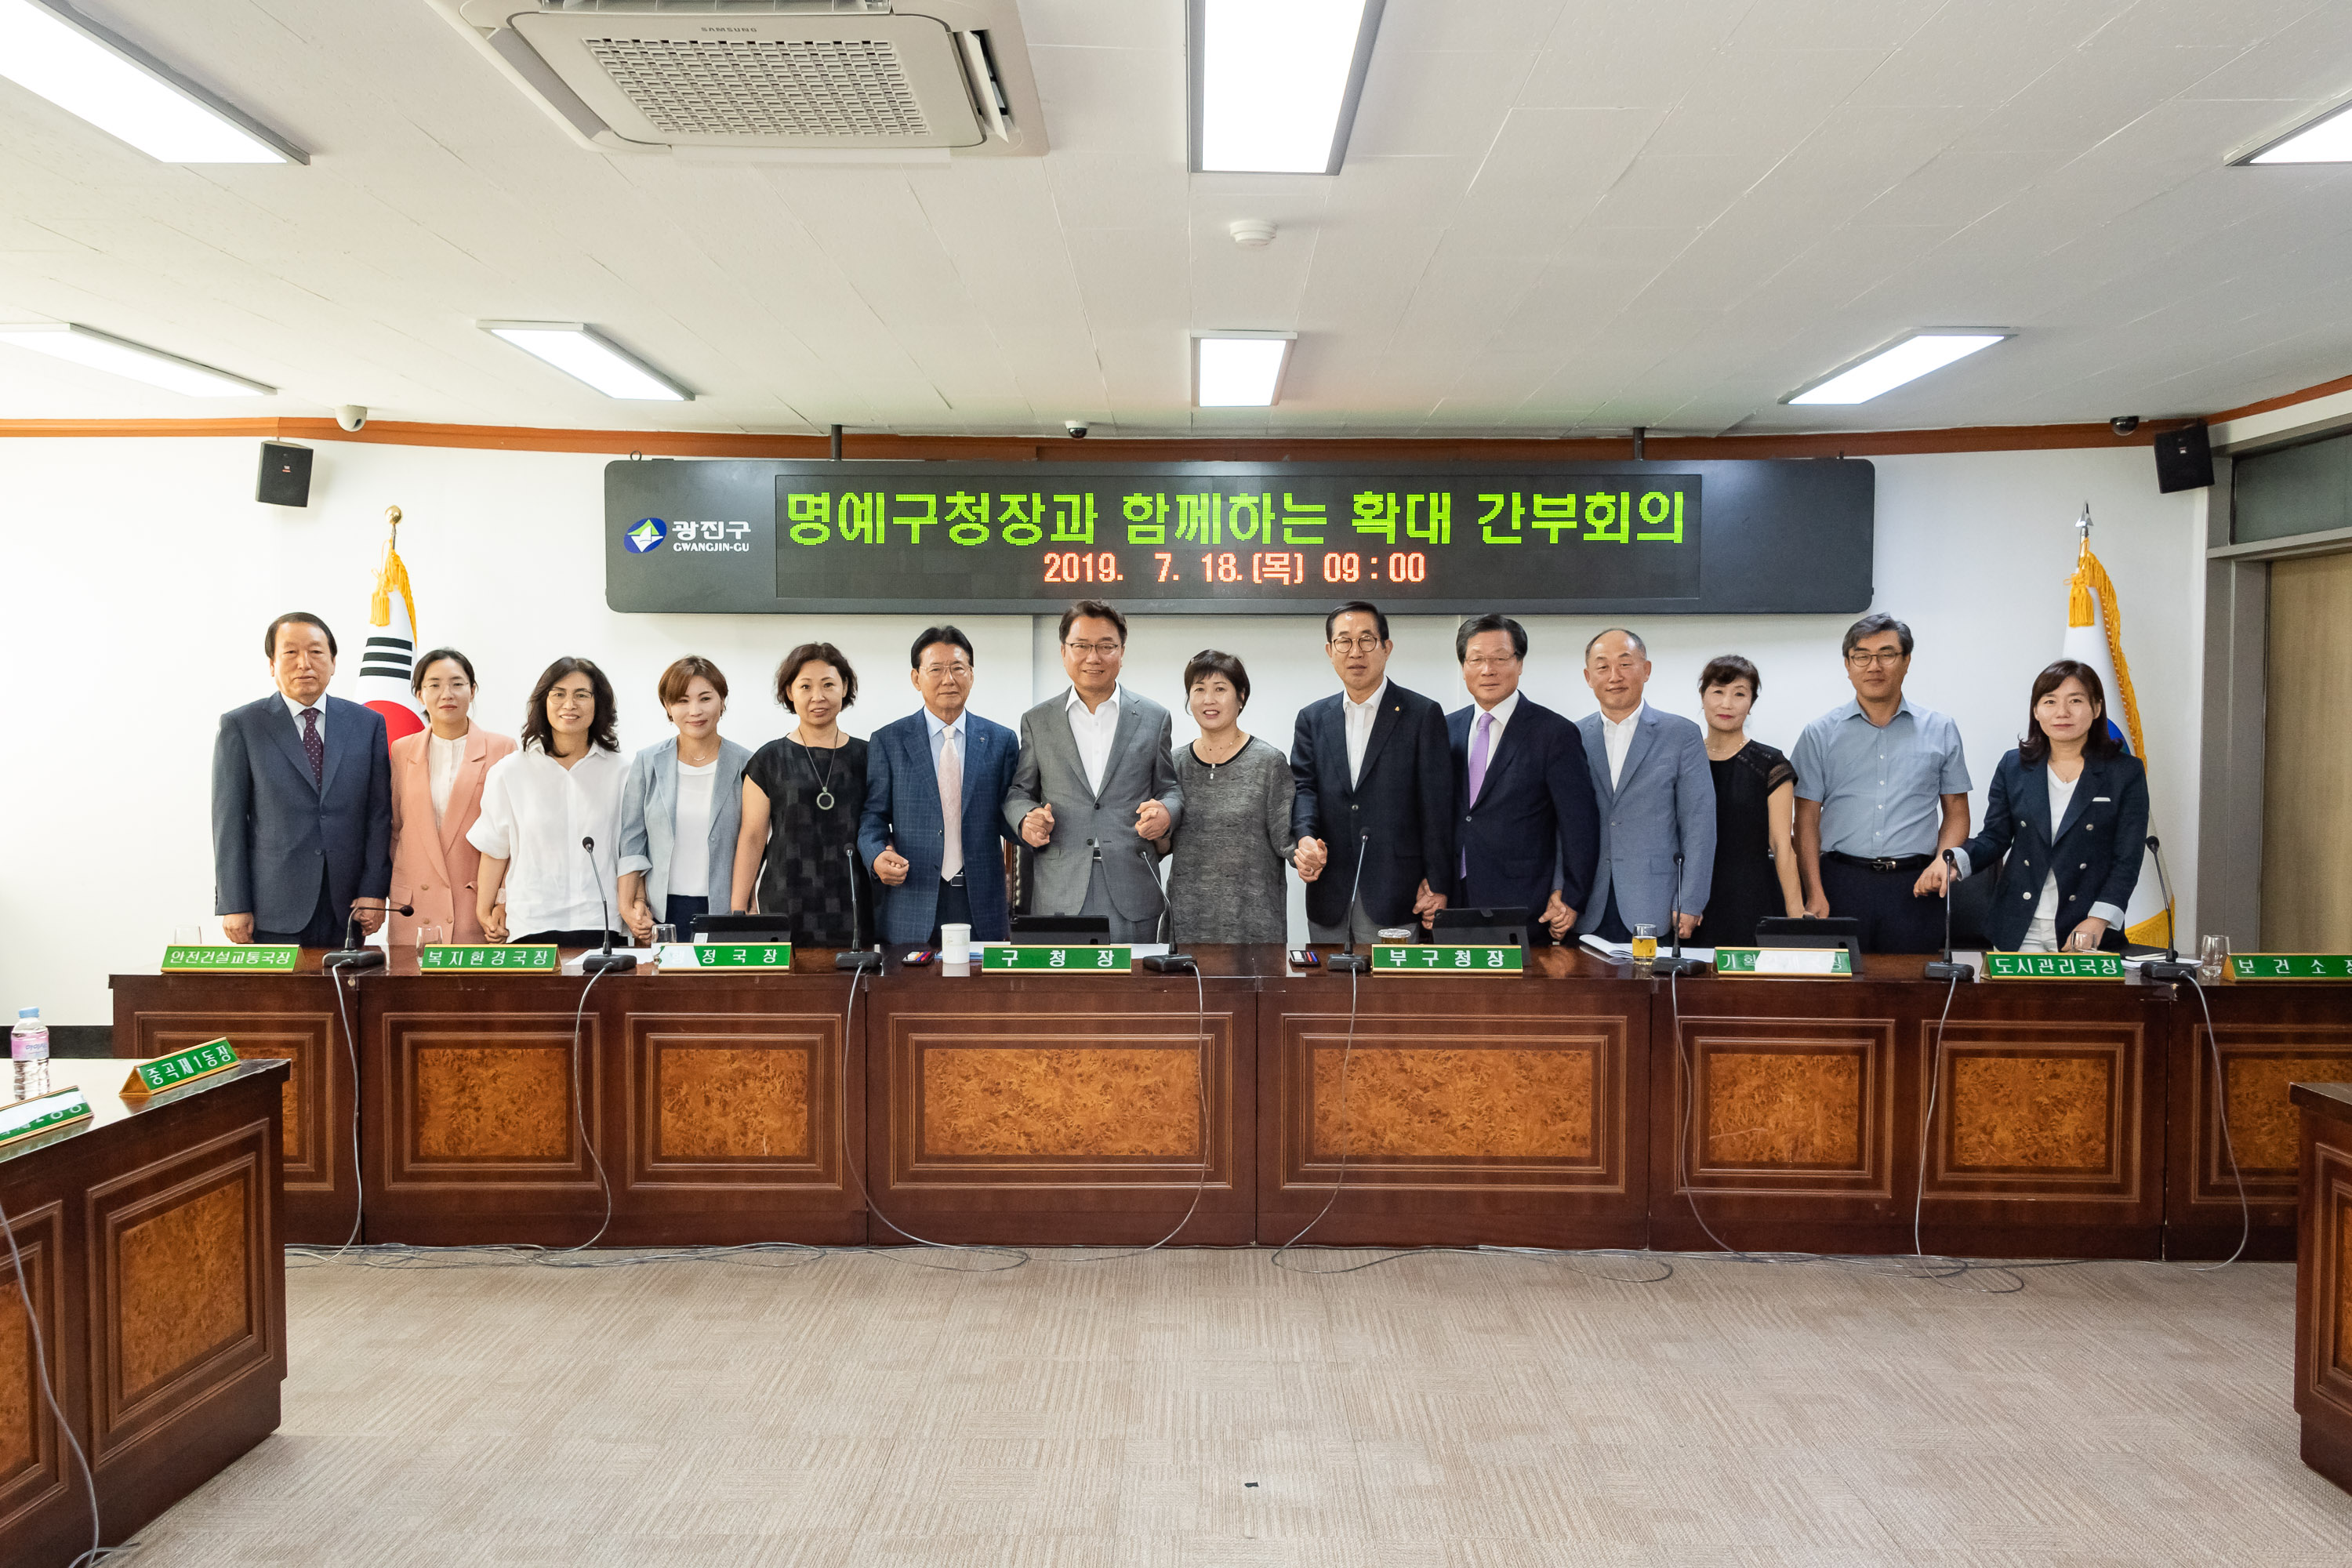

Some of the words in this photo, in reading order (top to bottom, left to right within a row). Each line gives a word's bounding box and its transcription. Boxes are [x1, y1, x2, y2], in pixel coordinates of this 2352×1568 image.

[788, 492, 1098, 545] 명예구청장과
[1123, 492, 1327, 545] 함께하는
[1352, 491, 1451, 544] 확대
[1478, 492, 1683, 544] 간부회의
[672, 521, 751, 541] 광진구
[673, 543, 750, 552] GWANGJIN-GU
[1044, 552, 1123, 583] 2019.
[1154, 552, 1179, 583] 7.
[170, 951, 291, 964] 안전건설교통국장
[428, 950, 548, 966] 복지환경국장
[671, 949, 777, 964] 정국장
[1002, 949, 1114, 967] 구청장
[1390, 949, 1504, 967] 부구청장
[1994, 957, 2118, 975] 도시관리국장
[147, 1045, 231, 1085] 중곡제1동장
